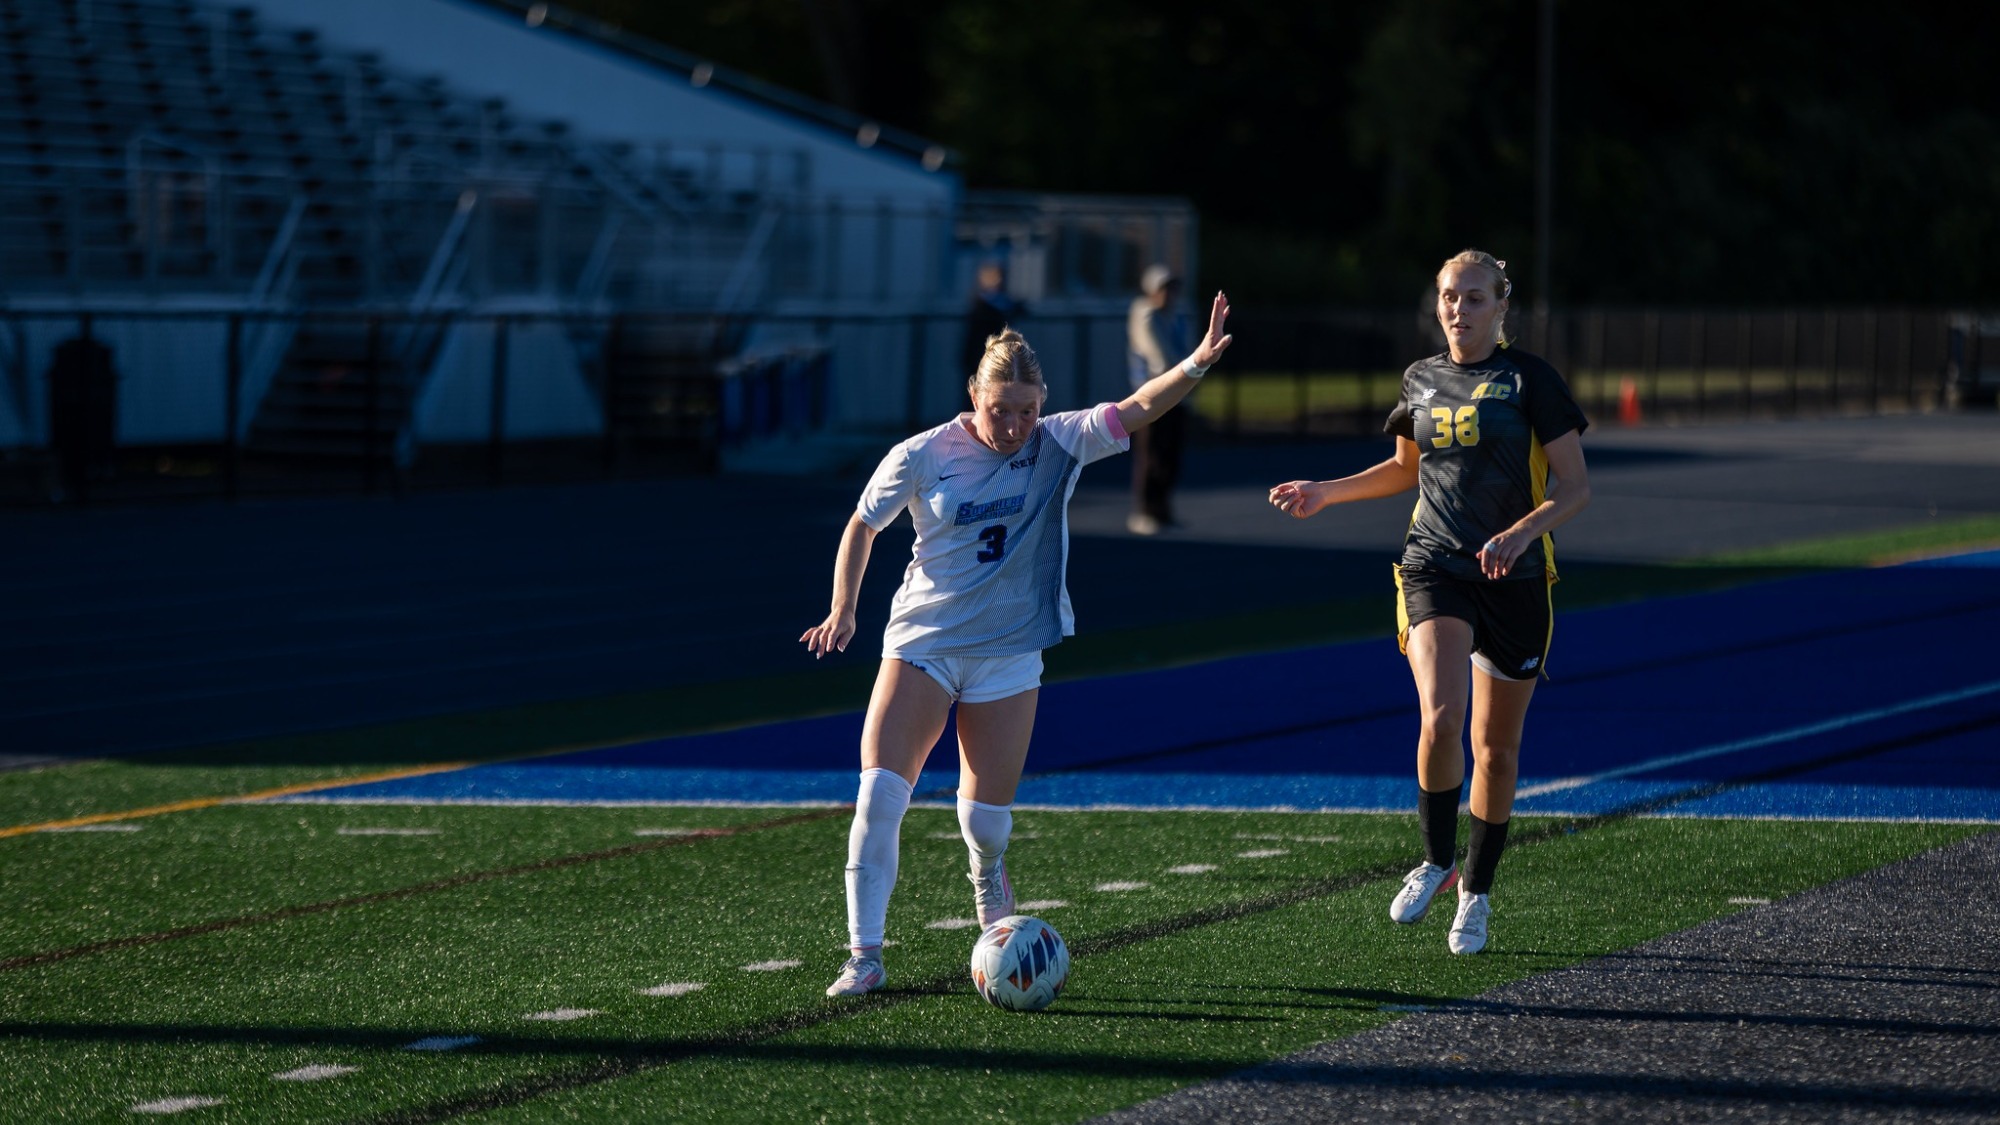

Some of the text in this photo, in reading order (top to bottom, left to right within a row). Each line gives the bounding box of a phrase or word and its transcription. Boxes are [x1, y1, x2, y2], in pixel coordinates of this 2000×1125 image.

[1470, 383, 1511, 400] AIC
[1431, 405, 1480, 448] 38
[977, 524, 1008, 564] 3
